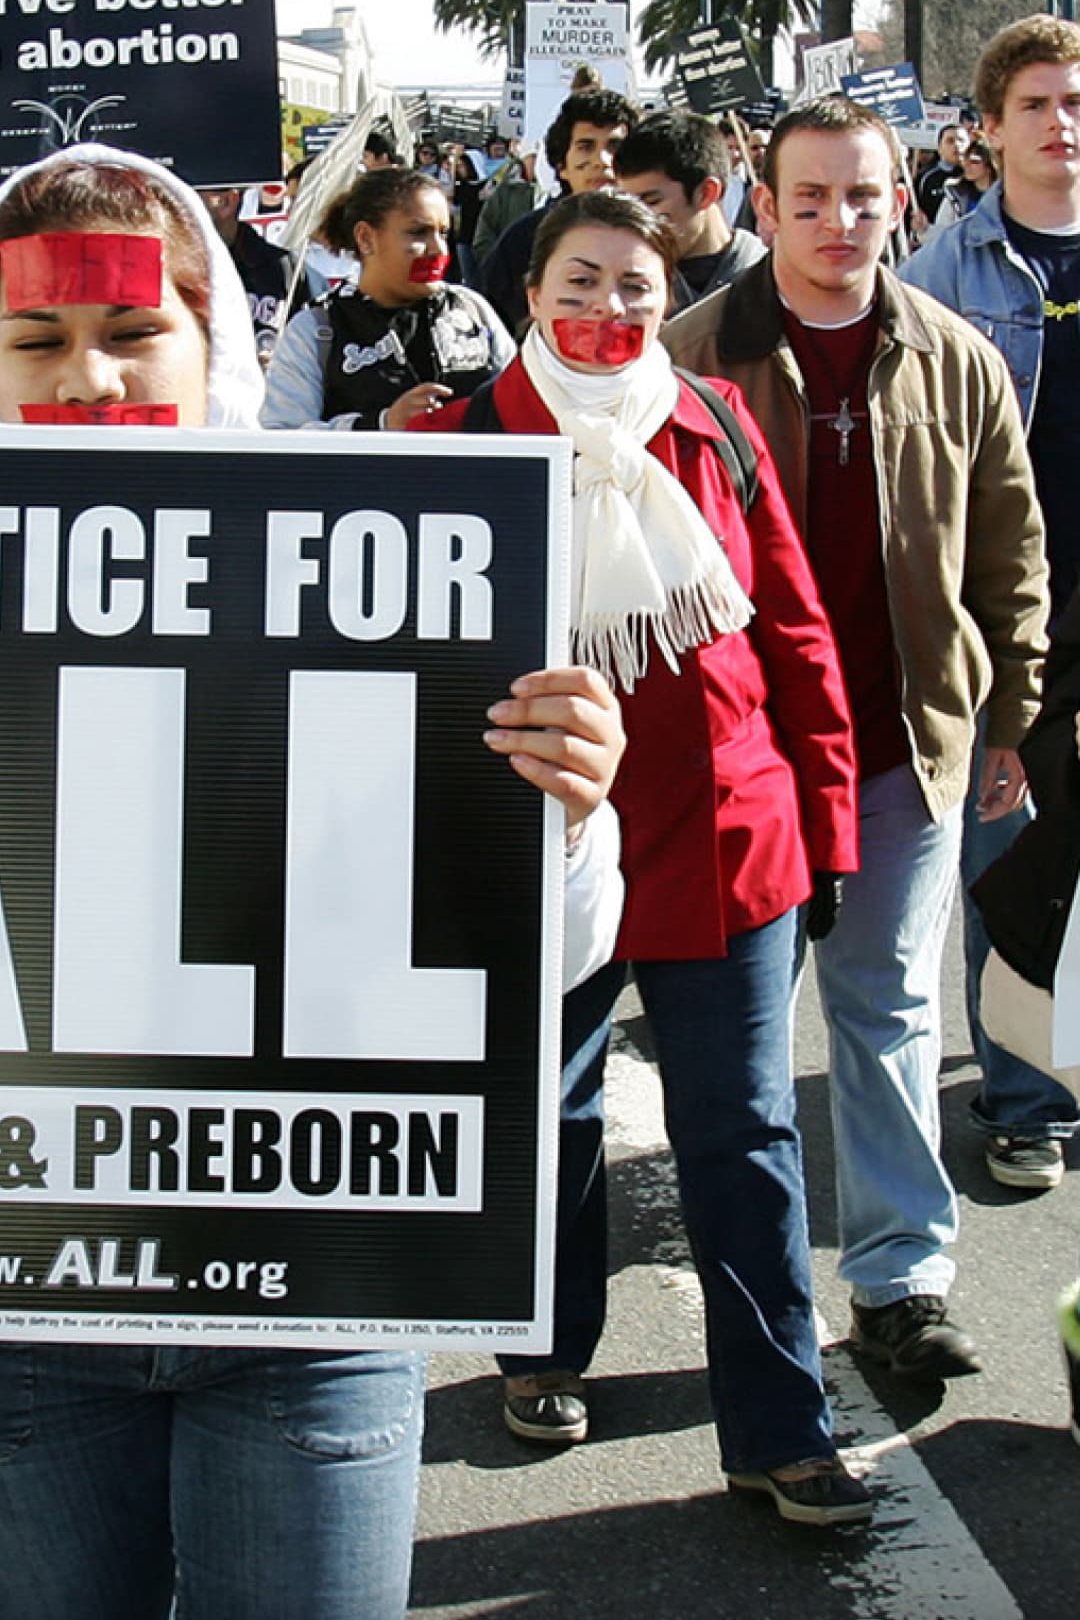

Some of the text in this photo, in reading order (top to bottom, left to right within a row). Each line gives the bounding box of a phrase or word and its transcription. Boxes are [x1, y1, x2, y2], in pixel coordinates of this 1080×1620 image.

[17, 23, 240, 71] abortion
[542, 30, 615, 45] MURDER
[264, 509, 494, 642] FOR
[0, 666, 488, 1062] LL
[0, 1103, 460, 1198] & PREBORN
